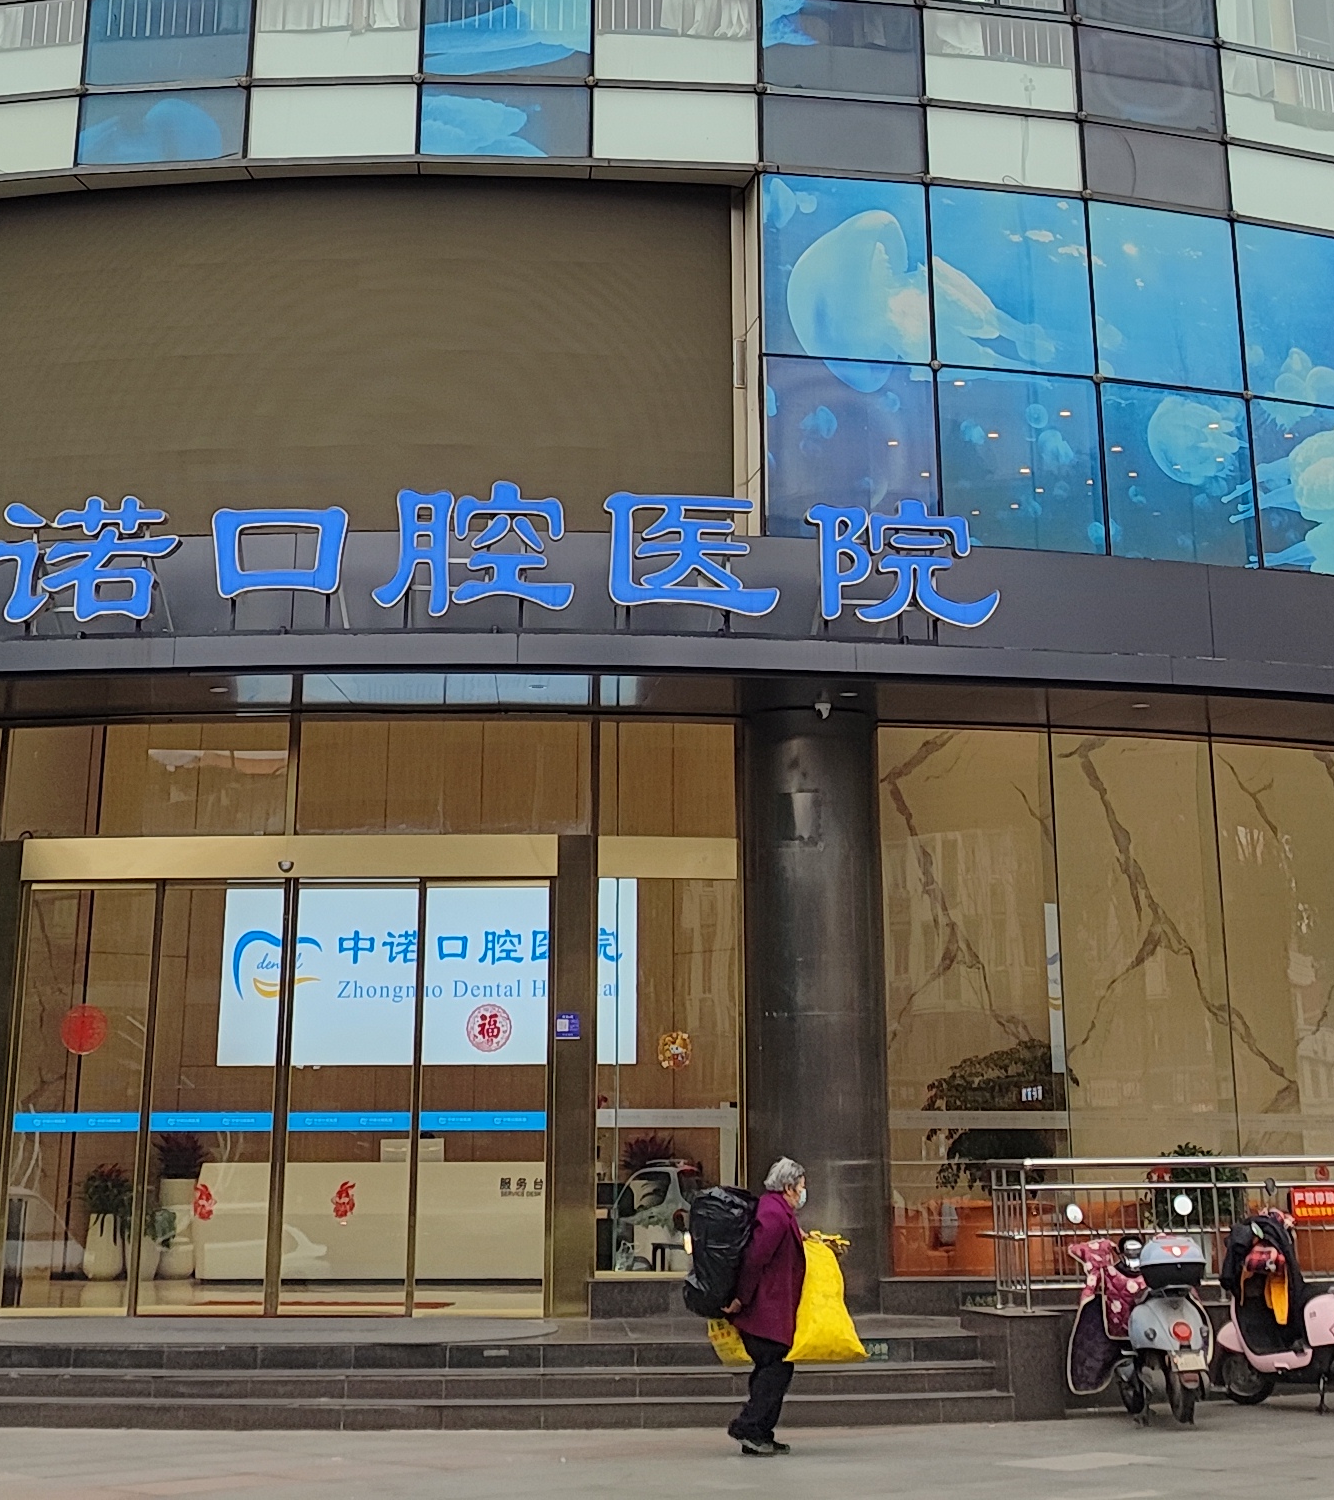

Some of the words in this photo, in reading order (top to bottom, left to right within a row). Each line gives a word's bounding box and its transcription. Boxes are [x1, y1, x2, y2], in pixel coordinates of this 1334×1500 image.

[452, 979, 522, 999] Dental
[499, 1177, 545, 1191] 服务台
